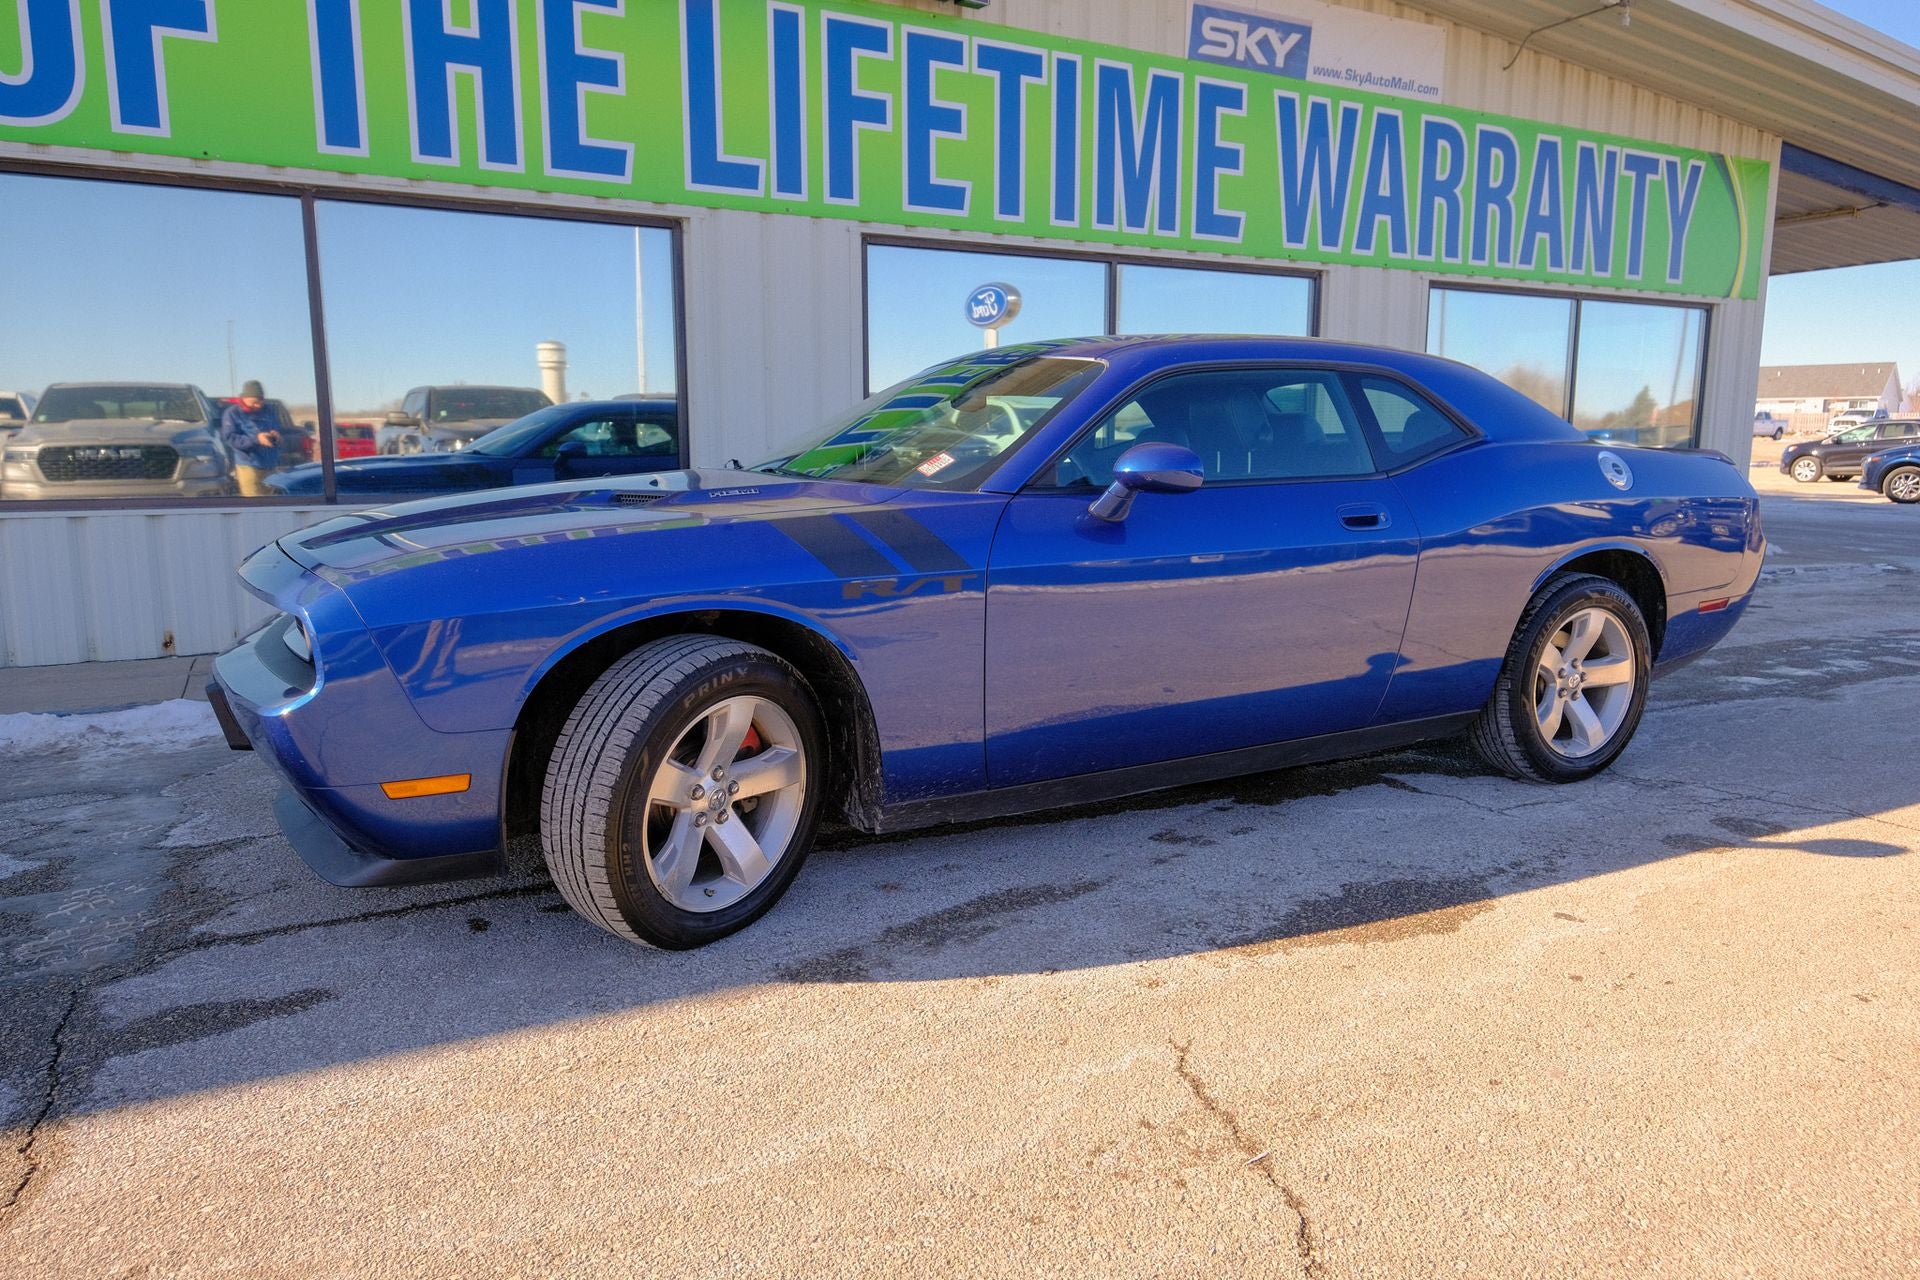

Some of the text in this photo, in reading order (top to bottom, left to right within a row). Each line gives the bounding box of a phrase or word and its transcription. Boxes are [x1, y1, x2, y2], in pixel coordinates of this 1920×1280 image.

[1197, 17, 1302, 68] SKY
[1313, 65, 1439, 97] www.SkyAutoMall.com
[679, 0, 1248, 244] LIFETIME
[1273, 89, 1706, 285] WARRANTY
[842, 575, 977, 599] R/T
